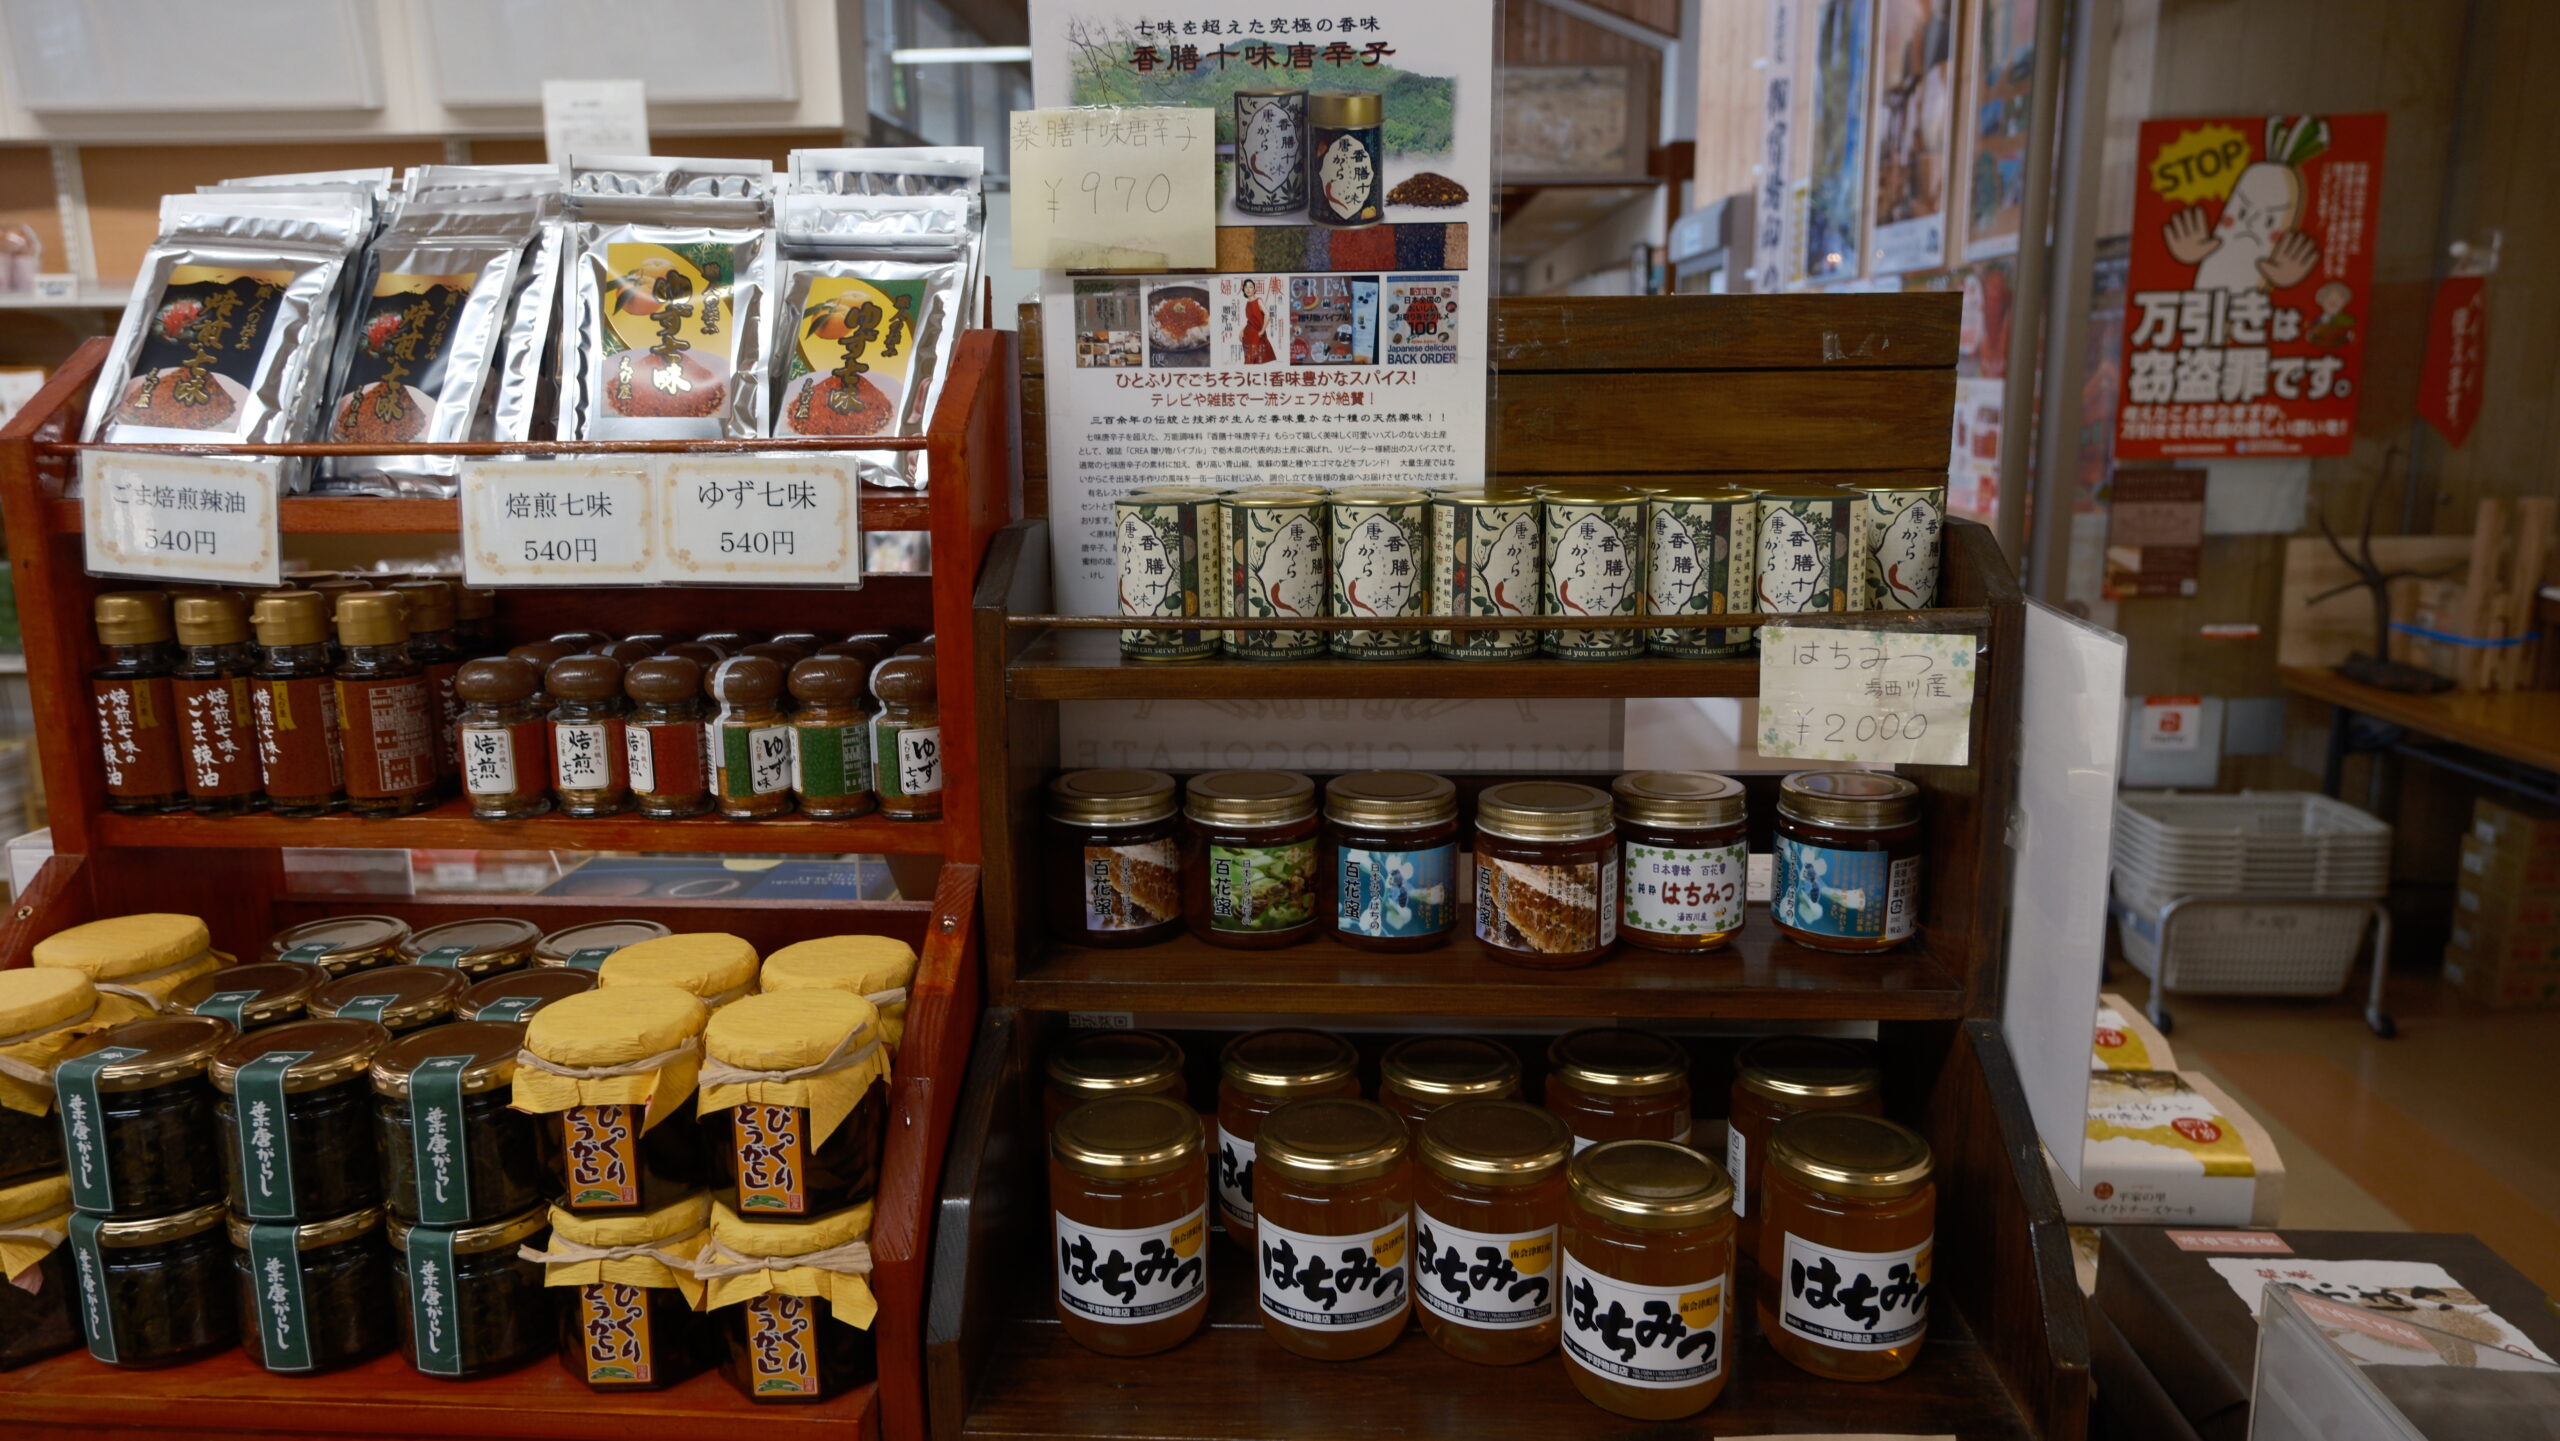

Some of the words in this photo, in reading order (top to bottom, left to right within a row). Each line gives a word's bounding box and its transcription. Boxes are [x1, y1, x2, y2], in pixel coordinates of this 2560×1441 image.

[1135, 16, 1381, 36] 七味を超えた究極の香味
[1129, 41, 1396, 73] 香膳十味唐辛子
[1012, 115, 1199, 151] 薬膳十味唐辛子
[2157, 140, 2244, 194] STOP
[1291, 278, 1349, 298] CREA
[650, 269, 694, 395] ゆず七味
[1408, 321, 1437, 336] 100
[2131, 290, 2300, 347] 万引きは
[174, 291, 244, 406] 焙煎七味
[374, 300, 435, 421] 焙煎七味
[828, 301, 884, 415] ゆず七味
[1387, 344, 1422, 354] Japanese
[1423, 344, 1457, 353] delicious
[1387, 354, 1419, 364] BACK
[1420, 353, 1457, 364] ORDER
[2128, 348, 2352, 403] 窃盗罪です。
[112, 484, 247, 515] ごま焙煎辣油
[505, 491, 613, 519] 焙煎七味
[698, 480, 817, 511] ゆず七味
[144, 528, 216, 556] 540円
[524, 538, 597, 563] 540円
[720, 530, 795, 555] 540円
[1775, 530, 1816, 607] 香膳十味
[1133, 534, 1166, 609] 香膳十味
[1378, 534, 1409, 609] 香膳十味
[1588, 535, 1626, 611] 香膳十味
[1659, 532, 1697, 607] 香膳十味
[1239, 648, 1268, 657] sprinkle
[1270, 649, 1285, 657] and
[1288, 649, 1302, 658] you
[1363, 648, 1378, 657] you
[1456, 647, 1490, 657] sprinkle
[1492, 648, 1508, 656] and
[1573, 649, 1589, 658] you
[1591, 649, 1606, 657] can
[1608, 649, 1628, 657] serve
[1700, 645, 1735, 655] flavorful
[1793, 640, 1934, 674] はちみつ
[97, 694, 123, 787] ごま辣油
[109, 687, 142, 764] 焙煎七味の
[188, 694, 221, 787] ごま辣油
[206, 687, 241, 764] 焙煎七味の
[569, 730, 595, 775] 焙煎
[1797, 707, 1928, 745] ¥2000
[470, 764, 482, 790] 七味
[474, 733, 501, 779] 焙煎
[562, 761, 575, 786] 七味
[757, 765, 771, 789] 七味
[763, 736, 787, 781] ゆず
[906, 768, 921, 791] 七味
[913, 738, 939, 783] ゆず
[1092, 858, 1112, 918] 百花蜜
[1214, 857, 1232, 918] 百花蜜
[1344, 859, 1361, 921] 百花蜜
[1369, 862, 1381, 930] 日本みつばちの
[1661, 881, 1735, 907] はちみつ
[69, 1093, 93, 1190] 葉唐がらし
[248, 1101, 274, 1197] 葉唐がらし
[425, 1107, 451, 1203] 葉唐がらし
[1061, 1233, 1204, 1305] はちみつ
[1263, 1238, 1405, 1311] はちみつ
[1416, 1224, 1550, 1305] はちみつ
[79, 1247, 101, 1340] 葉唐がらし
[266, 1257, 290, 1350] 葉唐がらし
[419, 1259, 444, 1354] 葉唐がらし
[1565, 1276, 1717, 1363] はちみつ
